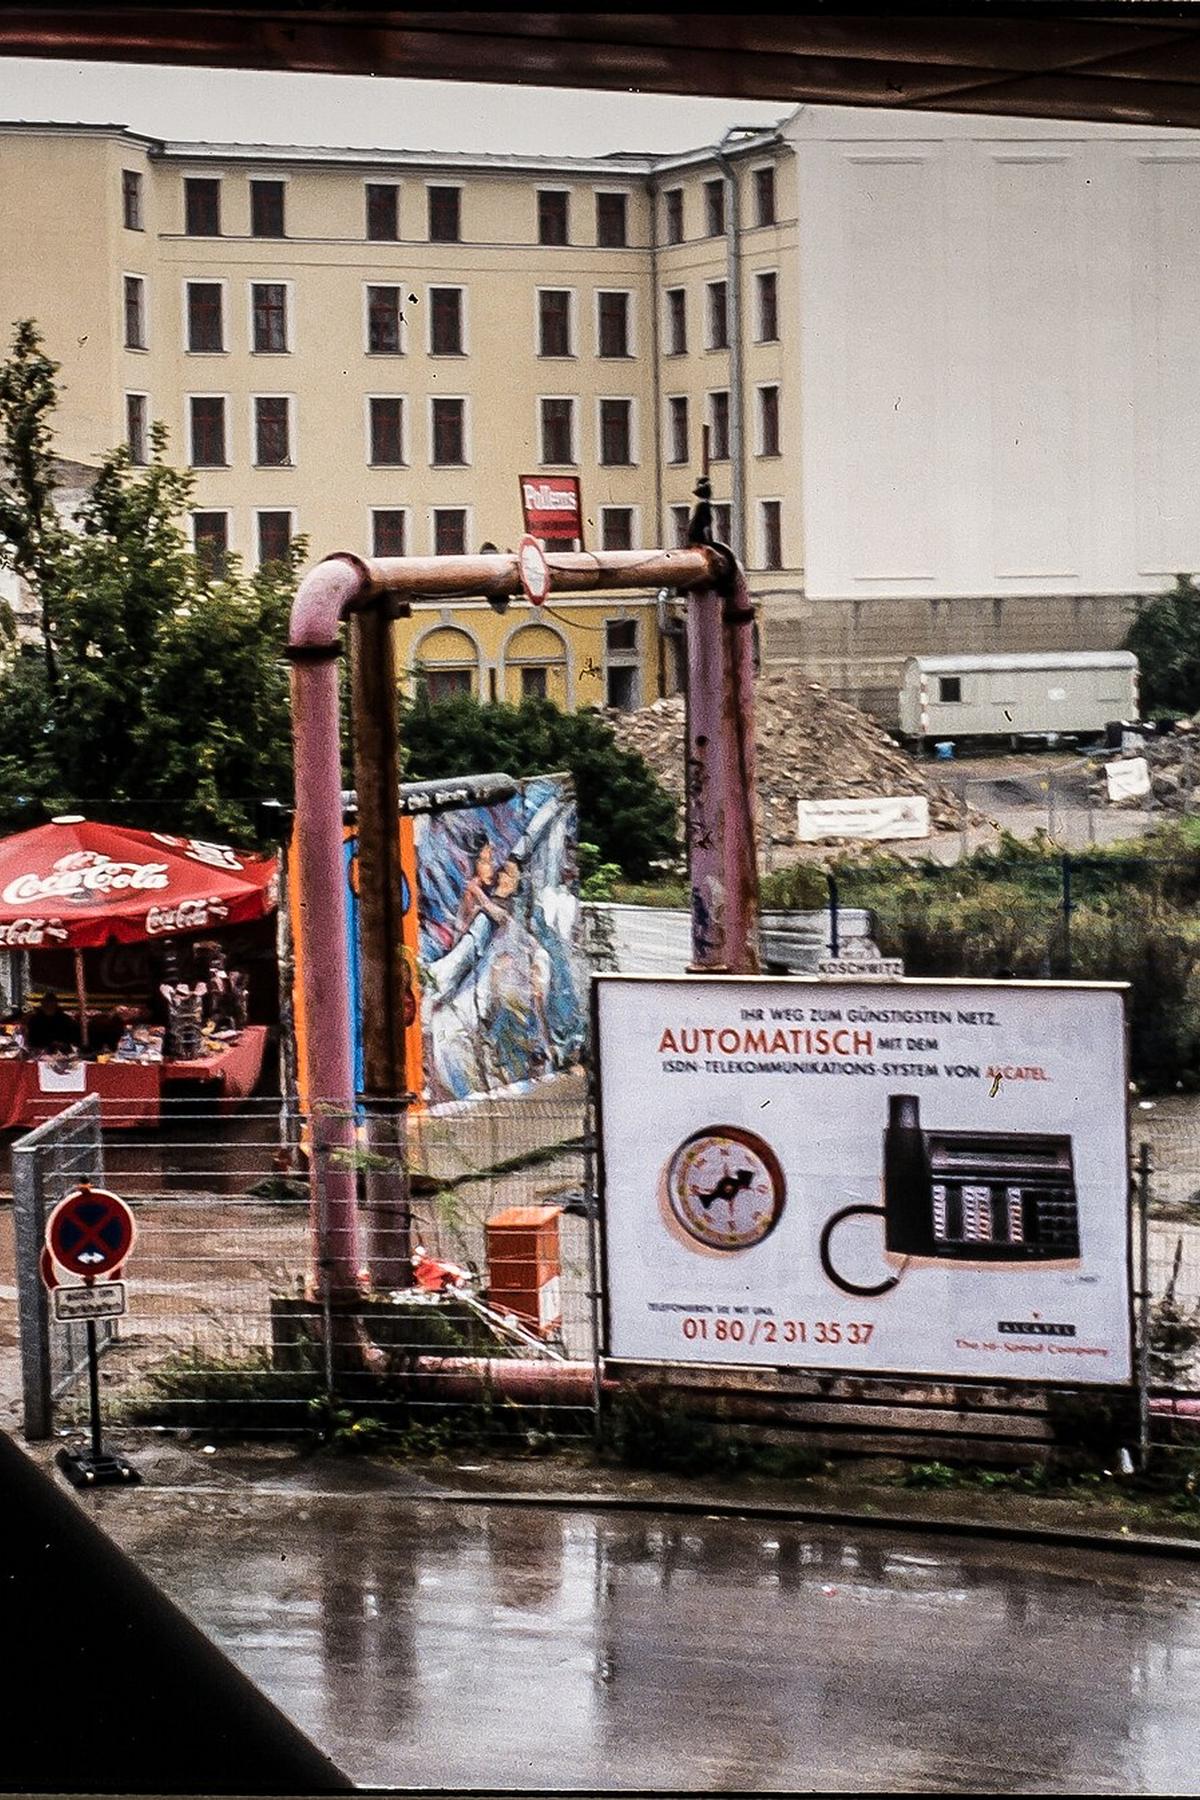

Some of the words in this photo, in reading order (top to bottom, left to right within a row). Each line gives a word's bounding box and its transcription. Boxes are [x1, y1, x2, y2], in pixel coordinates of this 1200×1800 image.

[740, 1008, 765, 1021] IHR
[769, 1008, 804, 1022] WEG
[809, 1008, 842, 1022] ZUM
[846, 1005, 952, 1024] GÜNSTIGSTEN
[956, 1010, 1001, 1026] NETZ.
[657, 1027, 873, 1055] AUTOMATISCH
[877, 1037, 902, 1050] MIT
[905, 1037, 939, 1051] DEM
[943, 1064, 981, 1078] VON
[1002, 1324, 1072, 1336] ALCATEL
